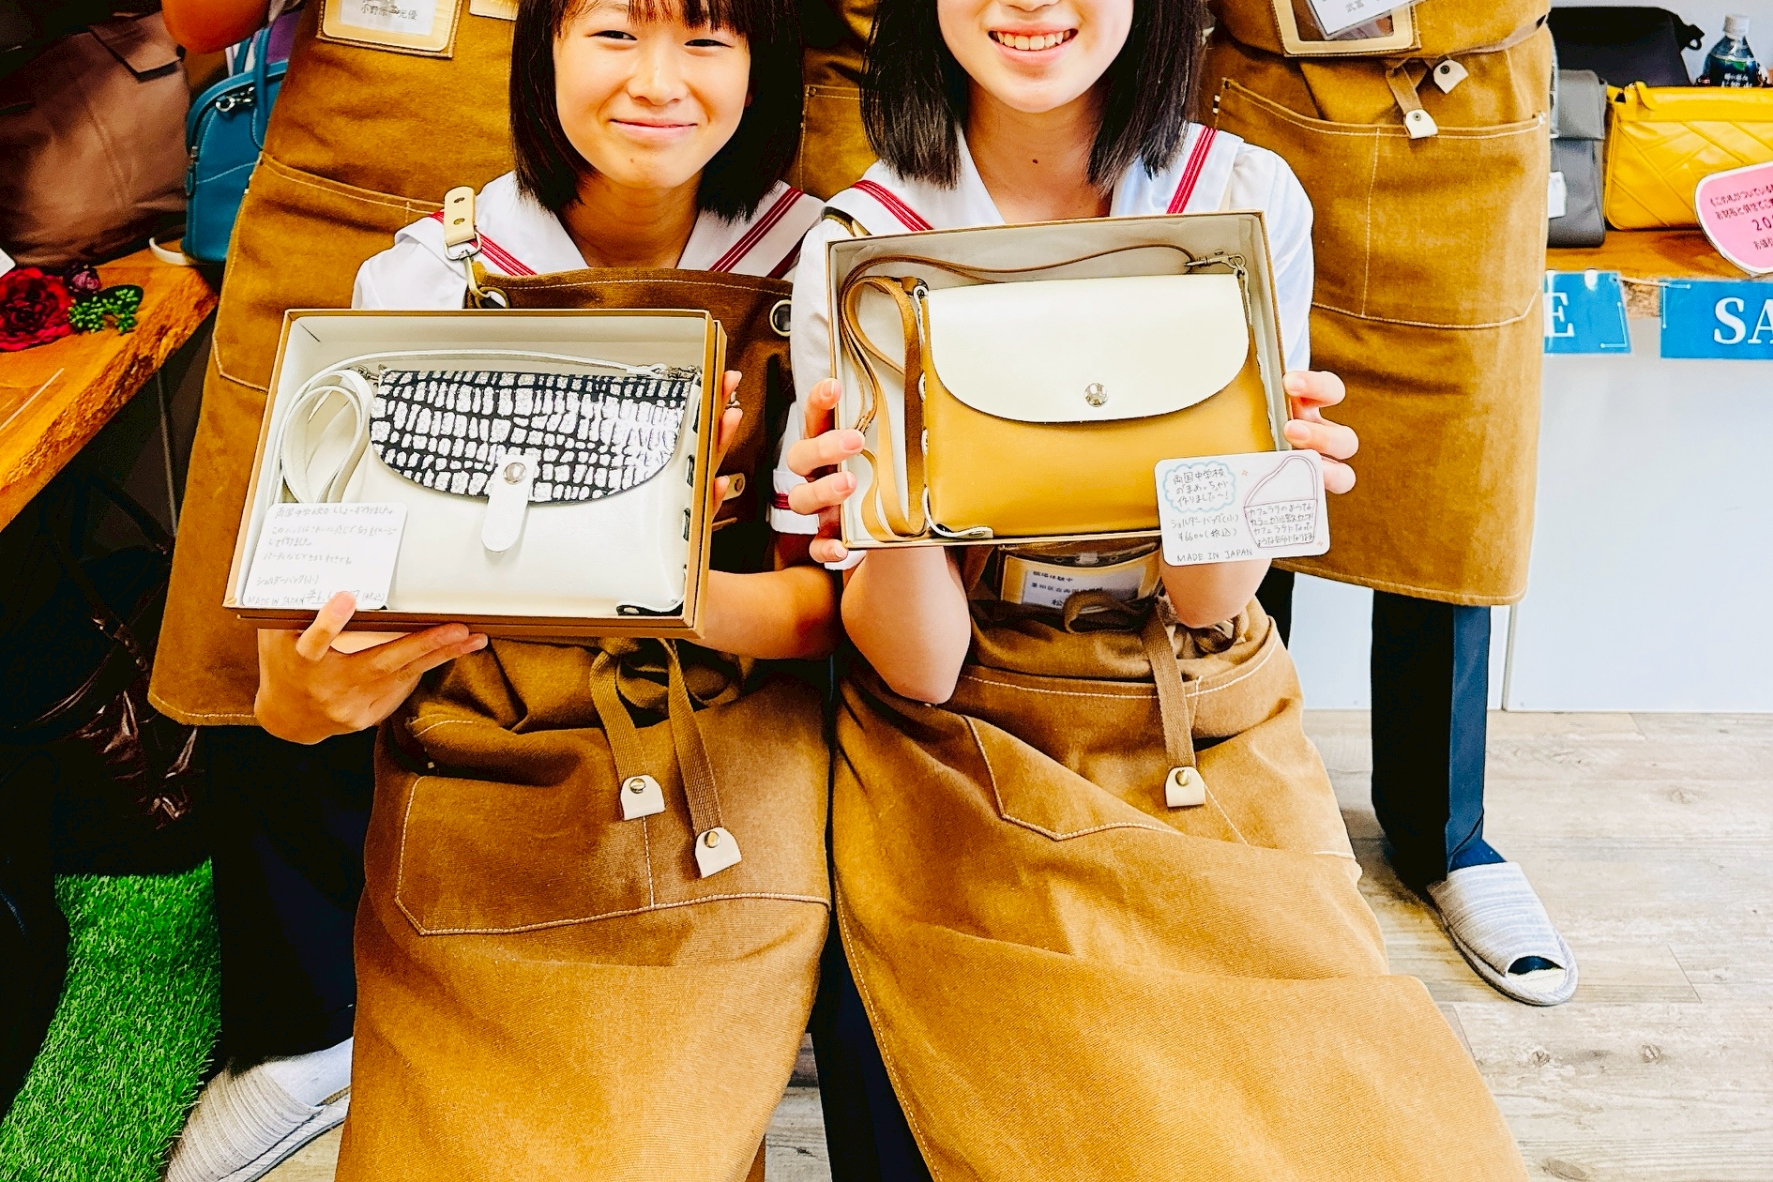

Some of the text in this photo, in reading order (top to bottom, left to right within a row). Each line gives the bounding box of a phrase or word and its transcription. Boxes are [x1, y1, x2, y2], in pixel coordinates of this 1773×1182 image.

[1751, 214, 1773, 232] 20
[1173, 467, 1227, 485] 両国中学校
[1176, 548, 1253, 563] MADE IN JAPAN
